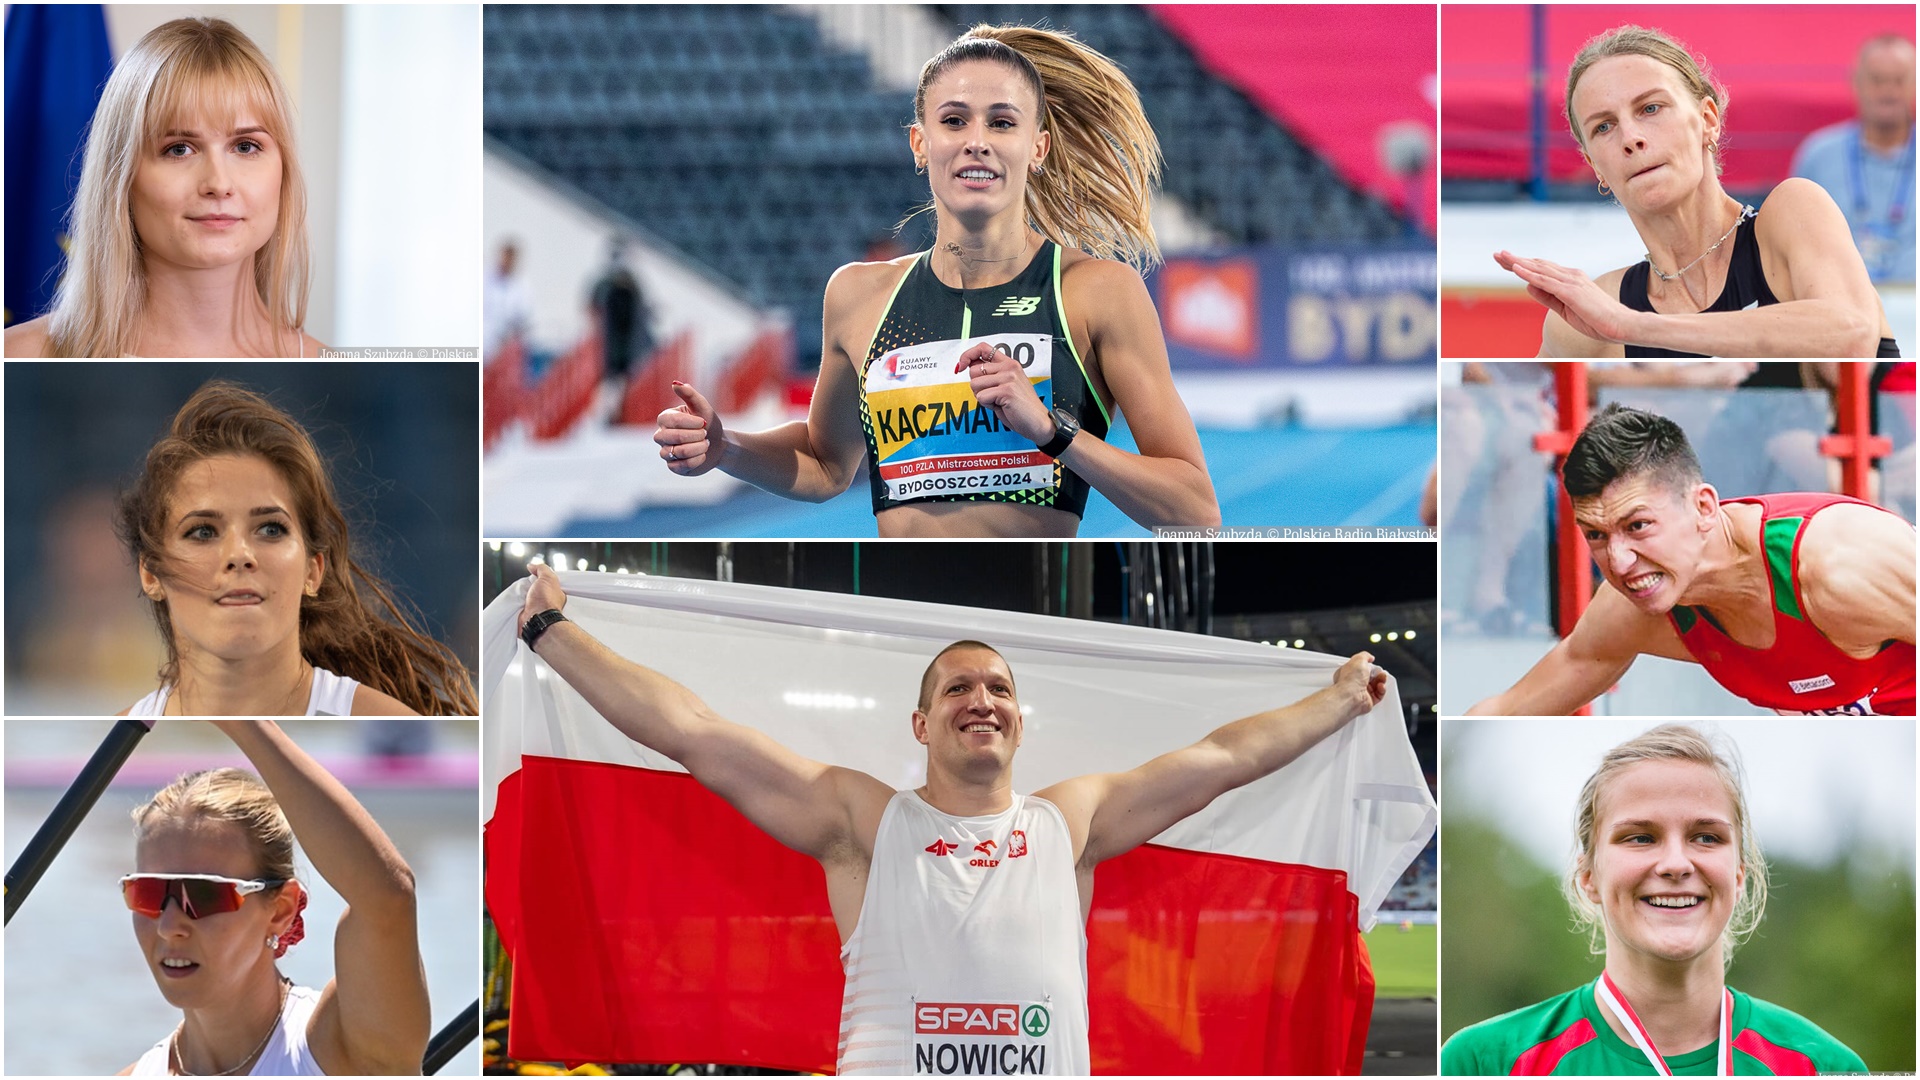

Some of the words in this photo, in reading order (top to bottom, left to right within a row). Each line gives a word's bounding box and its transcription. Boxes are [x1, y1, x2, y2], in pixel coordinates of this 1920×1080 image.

[1287, 294, 1438, 362] BYD
[900, 356, 931, 365] KUJAWY
[900, 362, 938, 371] POMORZE
[876, 396, 1046, 444] KACZMA
[900, 465, 914, 475] 100.
[916, 461, 935, 472] PZLA
[937, 458, 998, 470] Mistrzostwa
[1000, 454, 1030, 466] Polski
[898, 475, 989, 495] BYDGOSZCZ
[993, 472, 1032, 487] 2024
[918, 1007, 1017, 1031] SPAR
[916, 1043, 1046, 1075] NOWICKI
